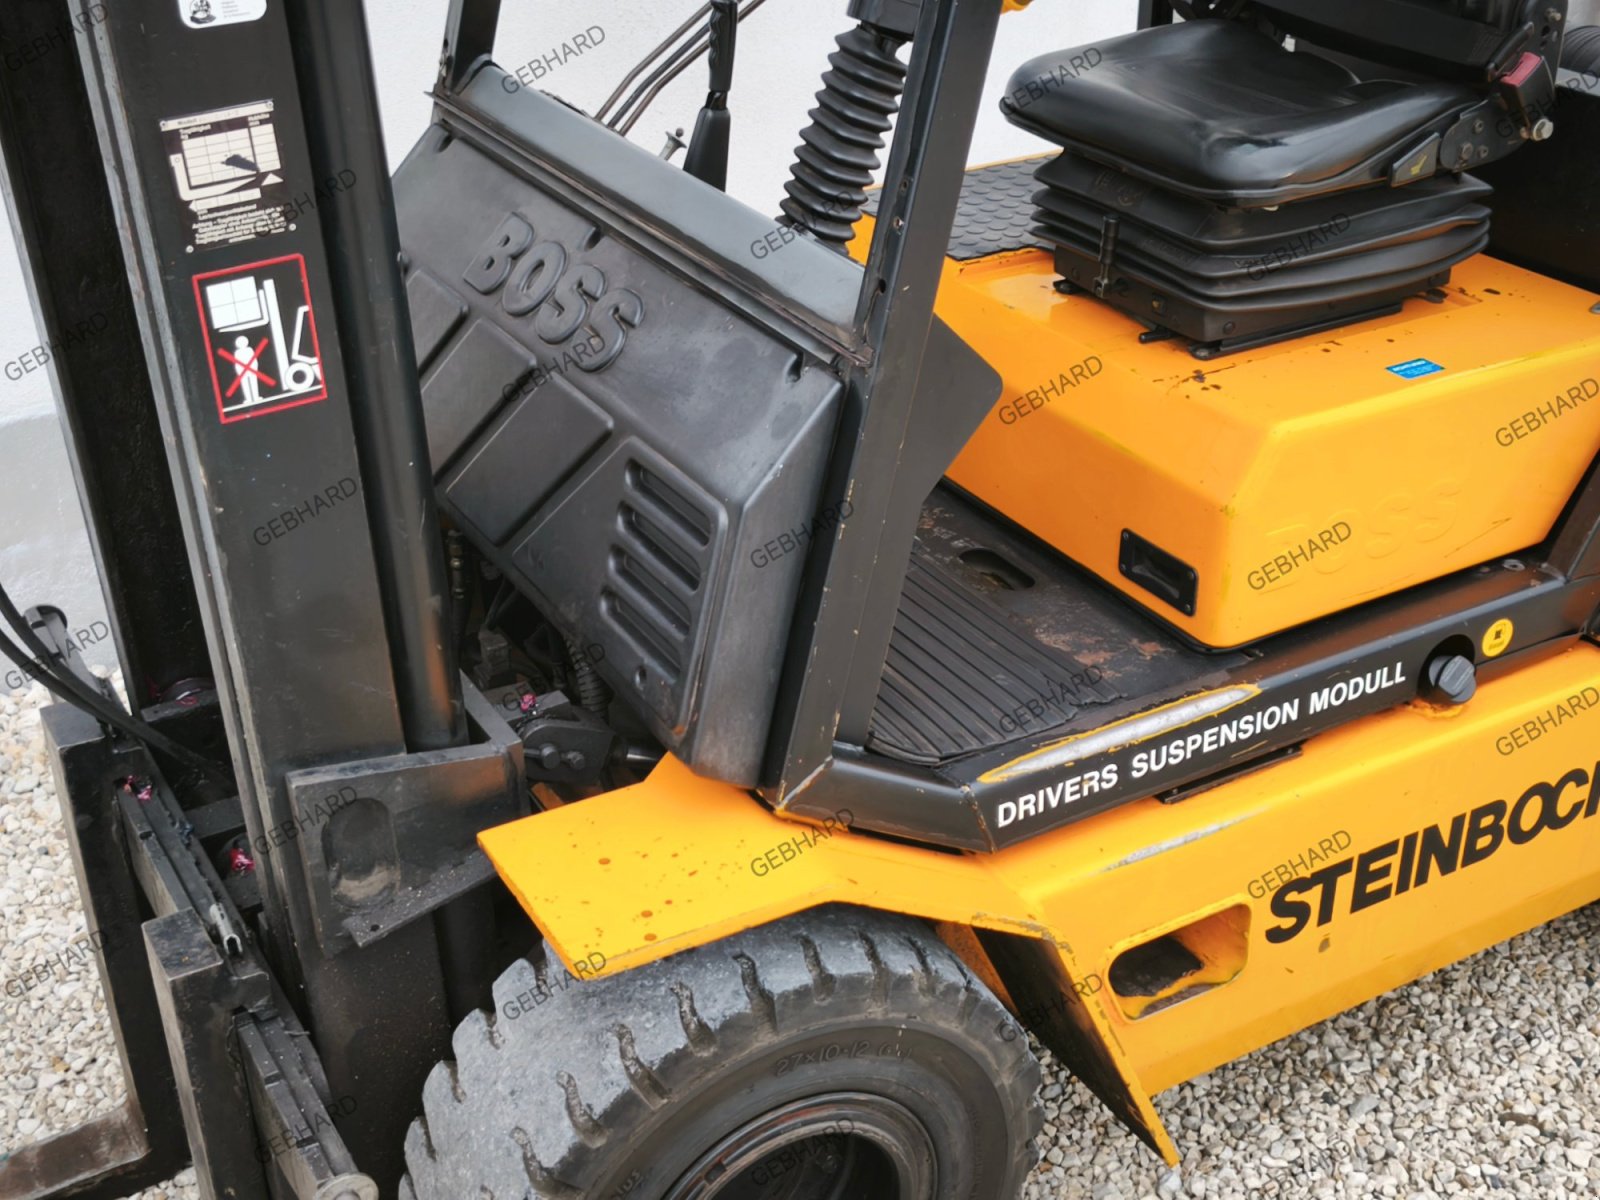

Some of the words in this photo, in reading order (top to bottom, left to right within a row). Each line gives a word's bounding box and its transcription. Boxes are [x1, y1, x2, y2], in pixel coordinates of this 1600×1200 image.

[463, 211, 646, 374] BOSS
[997, 764, 1119, 828] DRIVERS
[1131, 698, 1300, 779] SUSPENSION
[1309, 662, 1407, 715] MODULL
